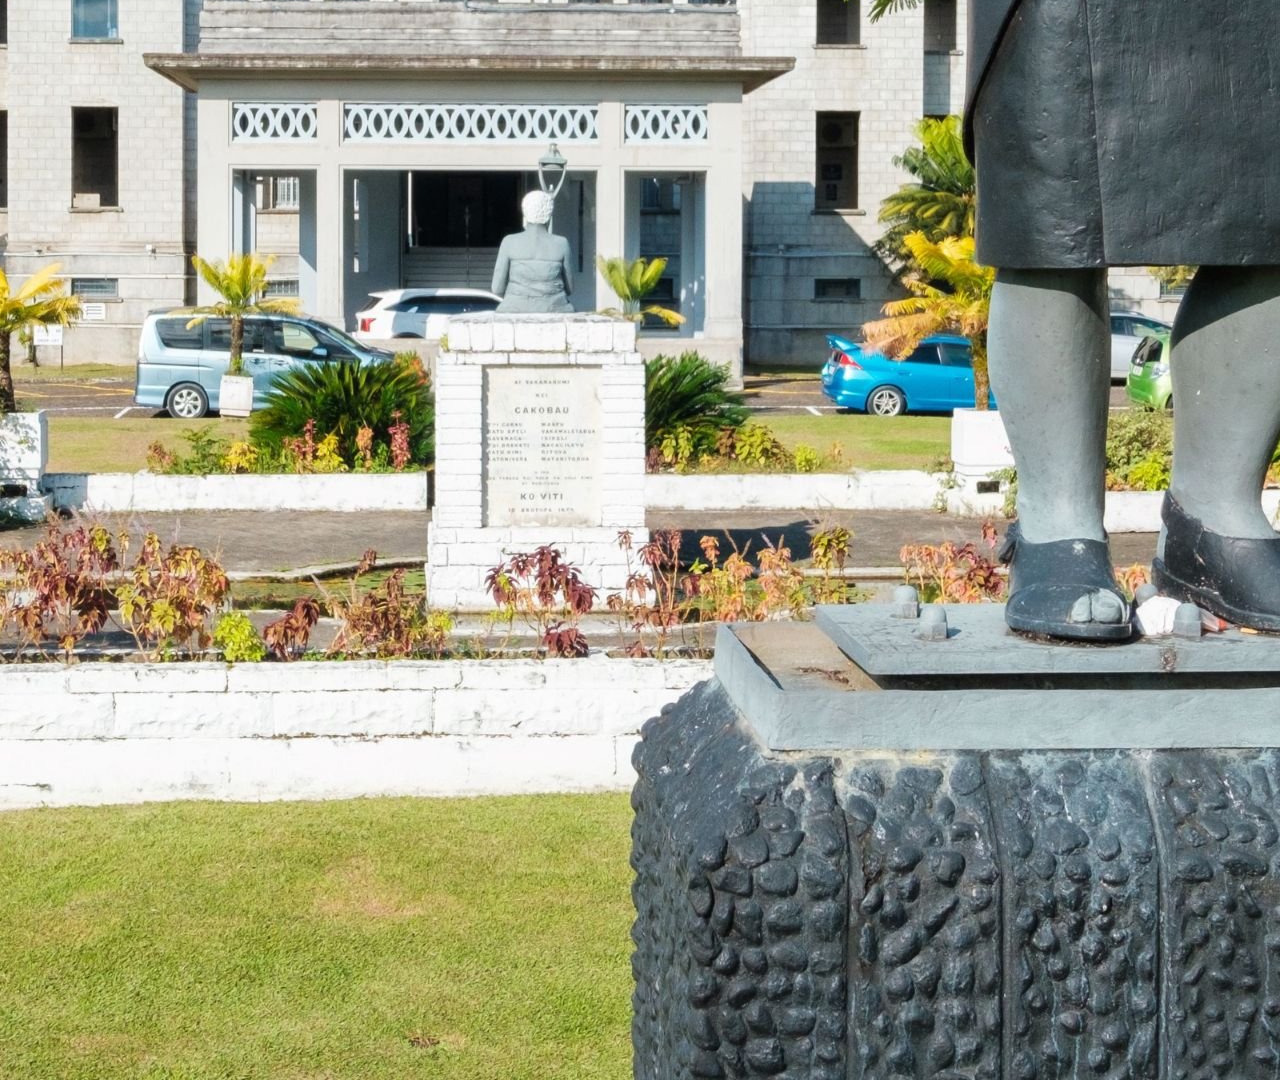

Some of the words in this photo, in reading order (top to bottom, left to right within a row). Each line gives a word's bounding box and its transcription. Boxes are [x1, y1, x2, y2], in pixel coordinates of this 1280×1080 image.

[514, 406, 570, 414] CAKOBAU
[520, 492, 535, 501] KO
[540, 492, 563, 501] VITI
